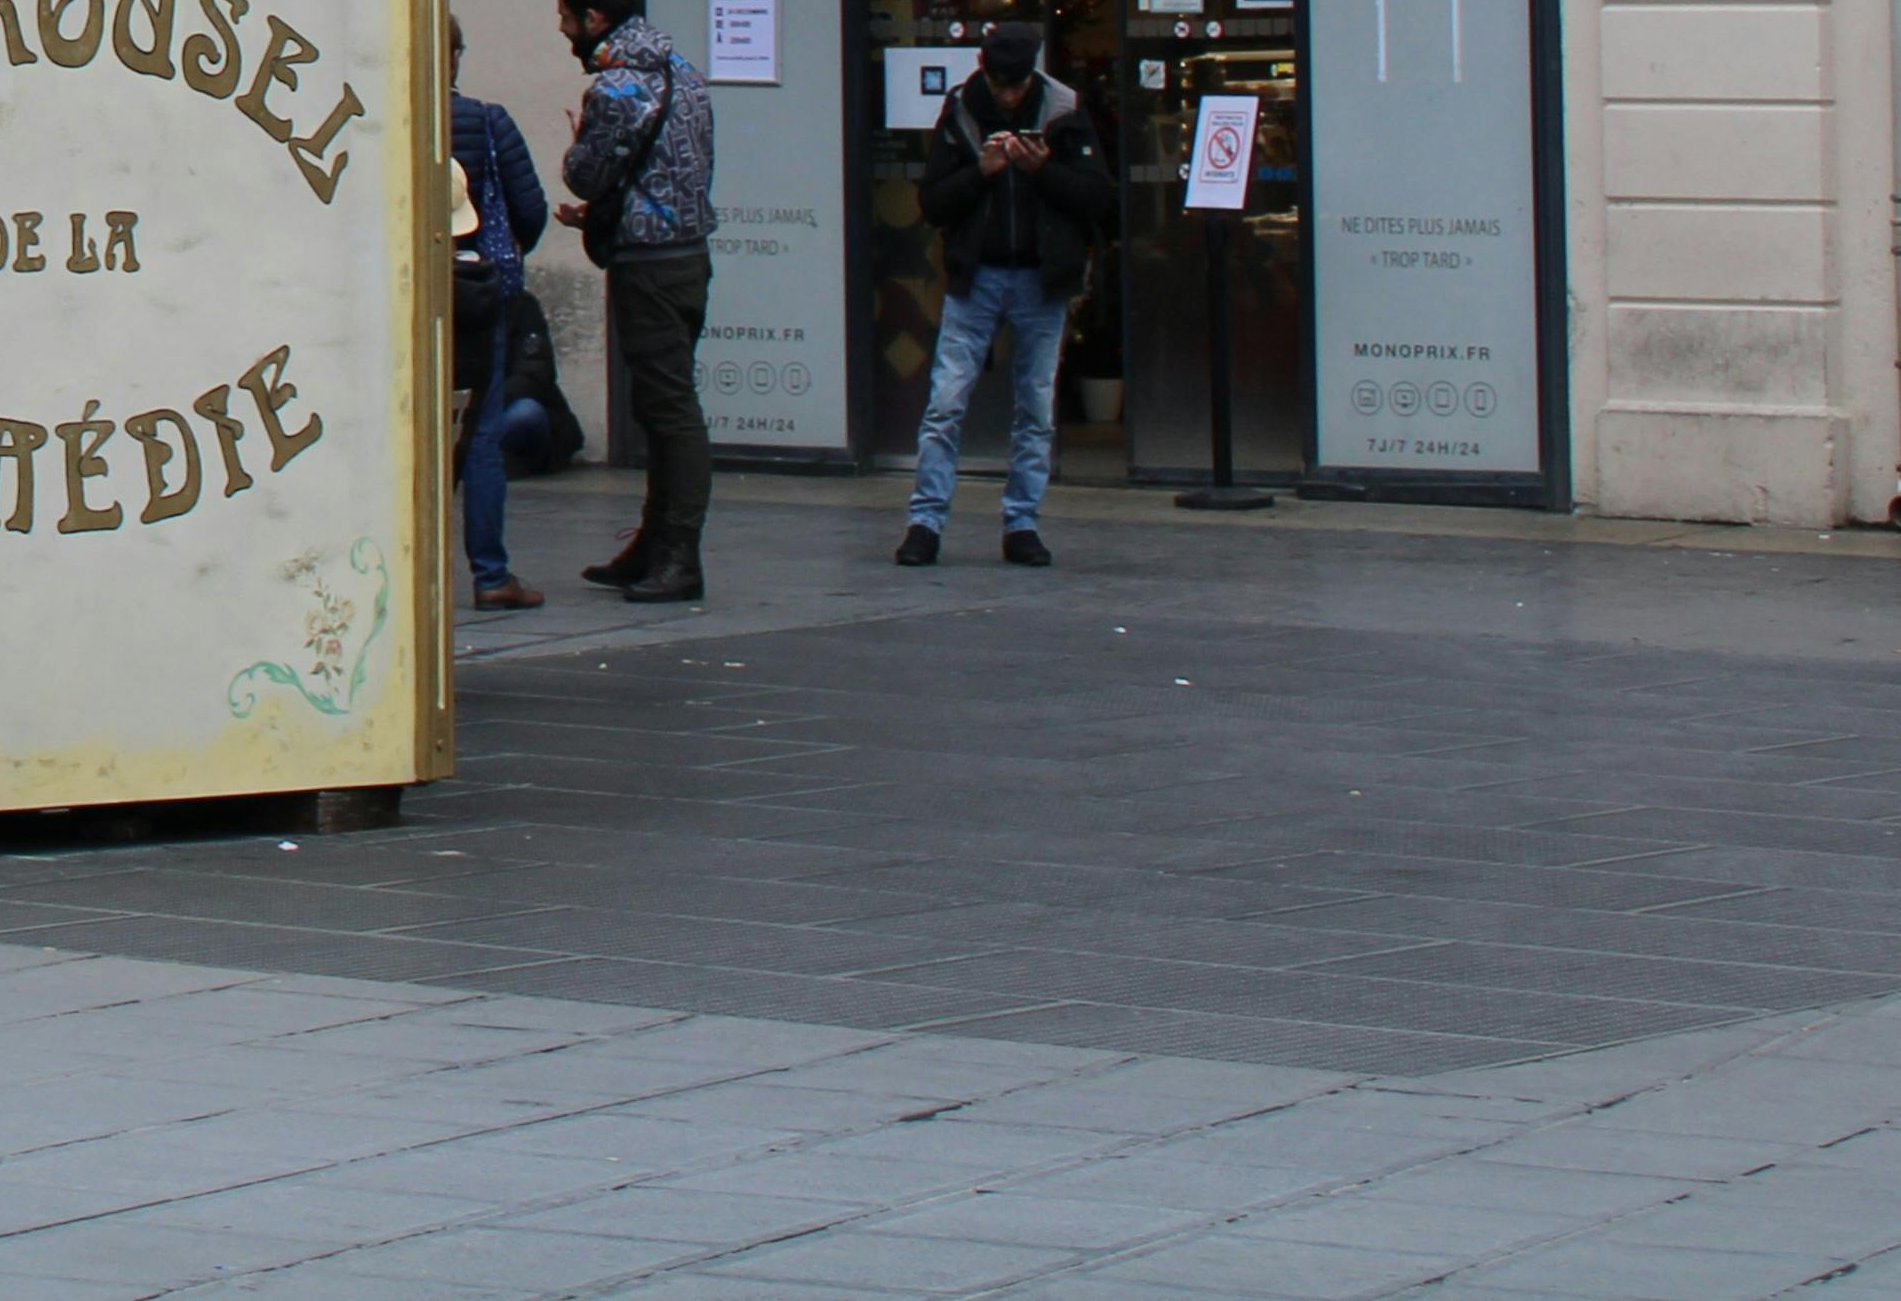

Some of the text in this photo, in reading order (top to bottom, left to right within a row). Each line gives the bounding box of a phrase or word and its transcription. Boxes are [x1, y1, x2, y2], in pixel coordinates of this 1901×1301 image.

[732, 207, 765, 224] PLUS
[767, 208, 815, 226] JAMAIS
[1341, 216, 1502, 237] NE DITES PLUS JAMAIS
[65, 211, 140, 273] LA
[746, 239, 779, 256] TARD
[1381, 250, 1420, 268] TROP
[1423, 251, 1460, 270] TARD
[700, 326, 806, 342] ONOPRIX.FR
[1353, 342, 1491, 361] MONOPRIX.FR
[736, 417, 796, 432] 24H/24
[1367, 437, 1482, 456] 7J/7 24H/24
